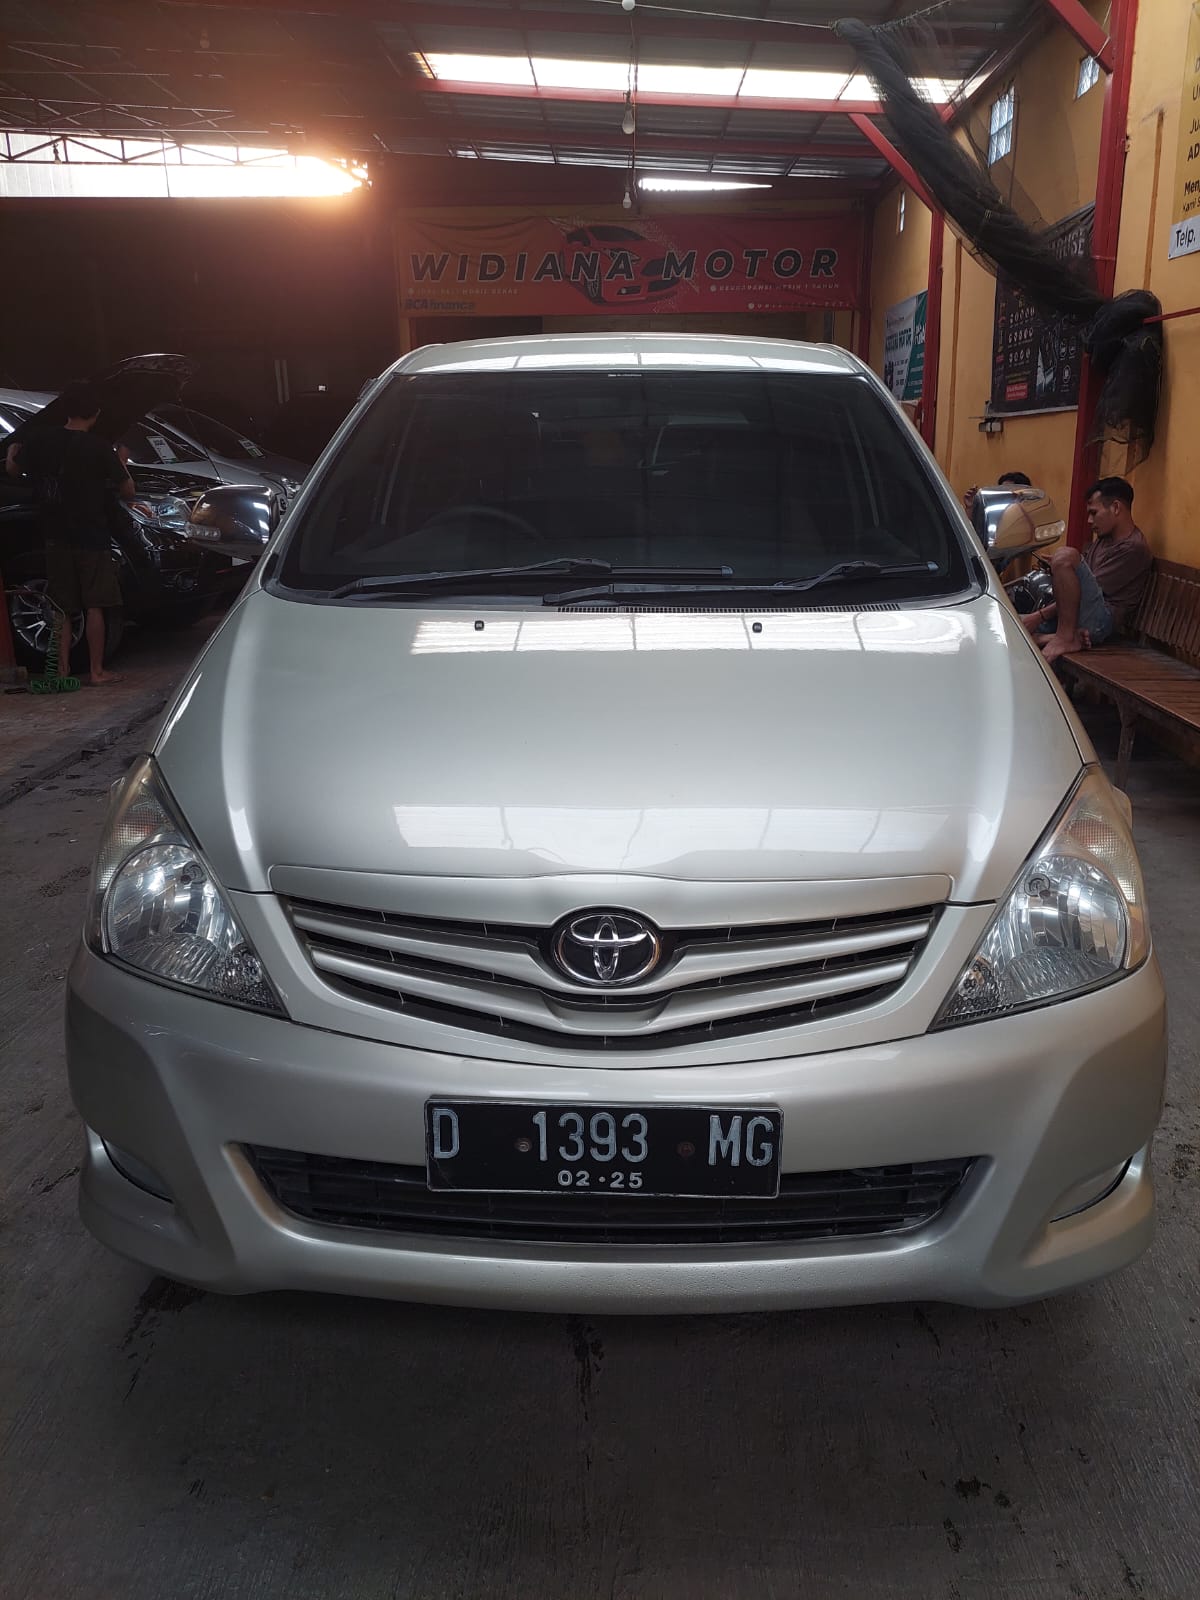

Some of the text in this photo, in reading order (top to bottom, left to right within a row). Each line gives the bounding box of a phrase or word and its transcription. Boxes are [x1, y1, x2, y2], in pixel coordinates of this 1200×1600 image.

[1176, 225, 1196, 248] Telp.
[409, 248, 840, 282] WIDIANA MOTOR
[432, 1108, 774, 1167] D 1393 MG
